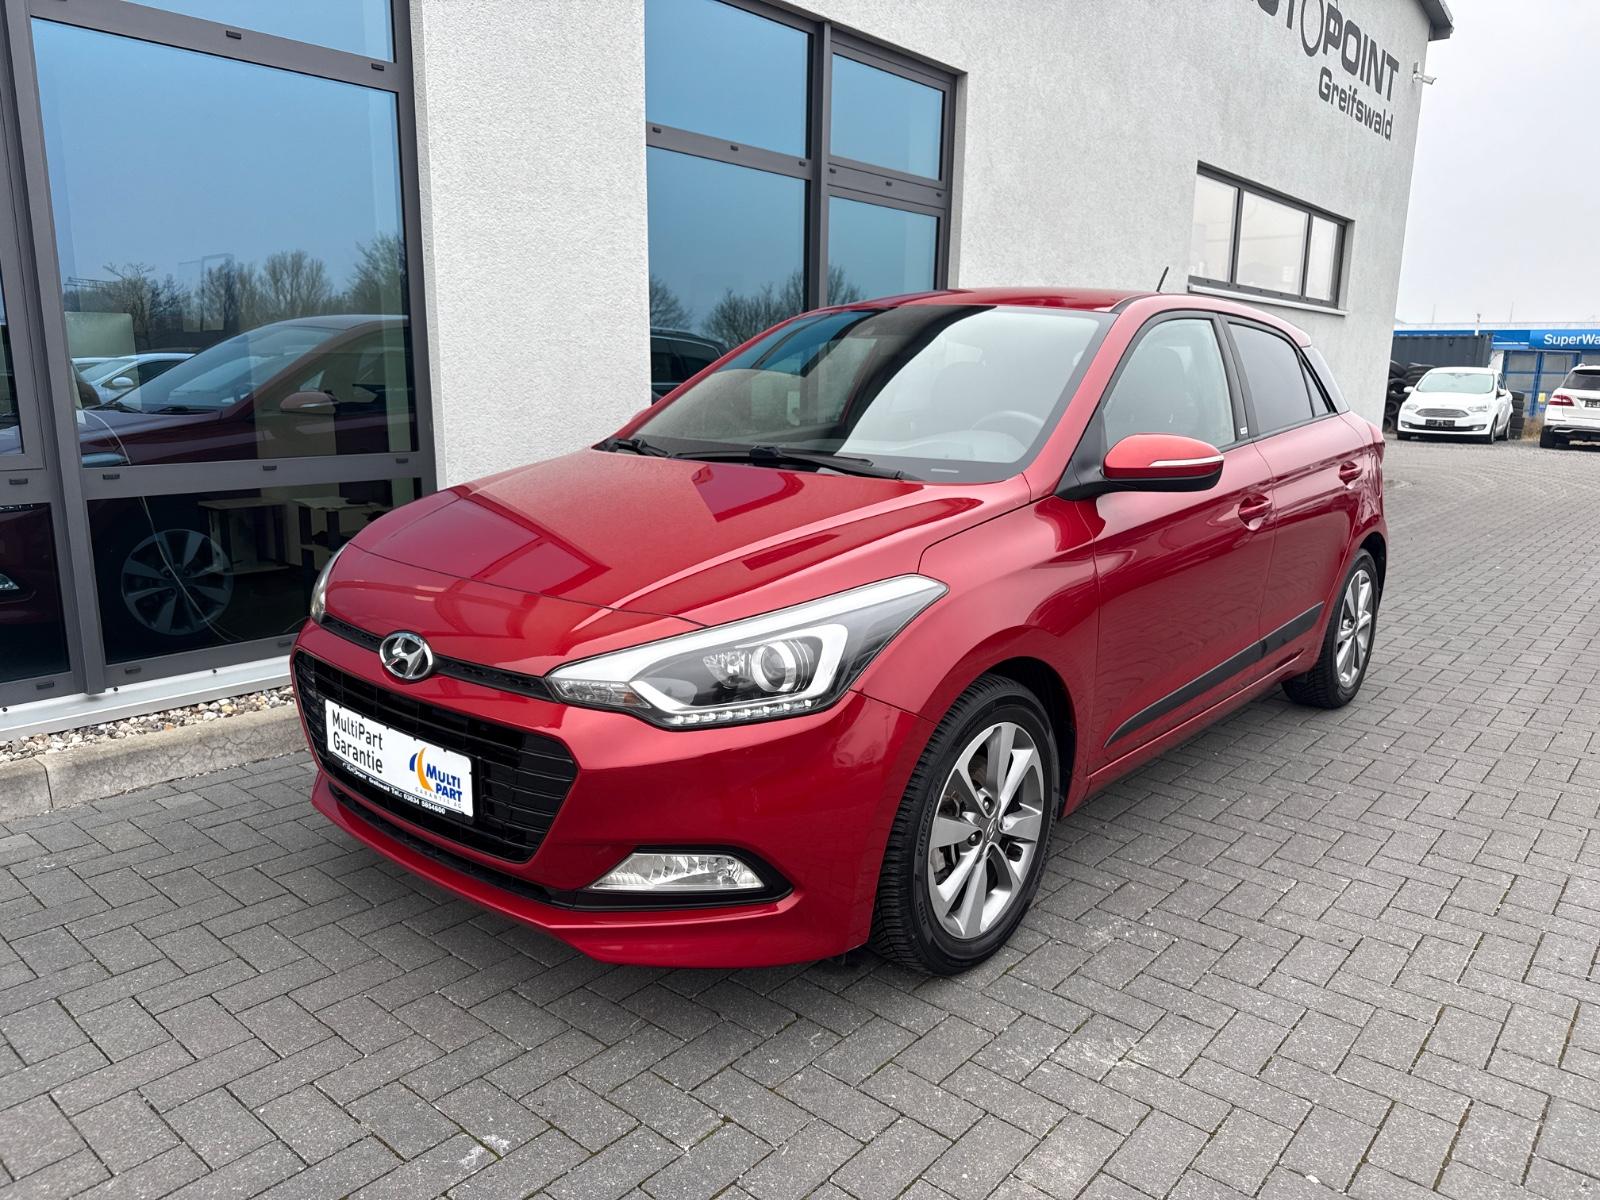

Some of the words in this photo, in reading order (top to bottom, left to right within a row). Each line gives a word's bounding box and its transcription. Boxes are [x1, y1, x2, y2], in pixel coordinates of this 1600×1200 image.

[1318, 66, 1393, 141] Greifswald
[1543, 333, 1600, 347] SuperWa
[332, 709, 383, 751] MultiPart
[333, 731, 383, 774] Garantie
[426, 763, 461, 789] MULTI
[435, 782, 463, 802] PART
